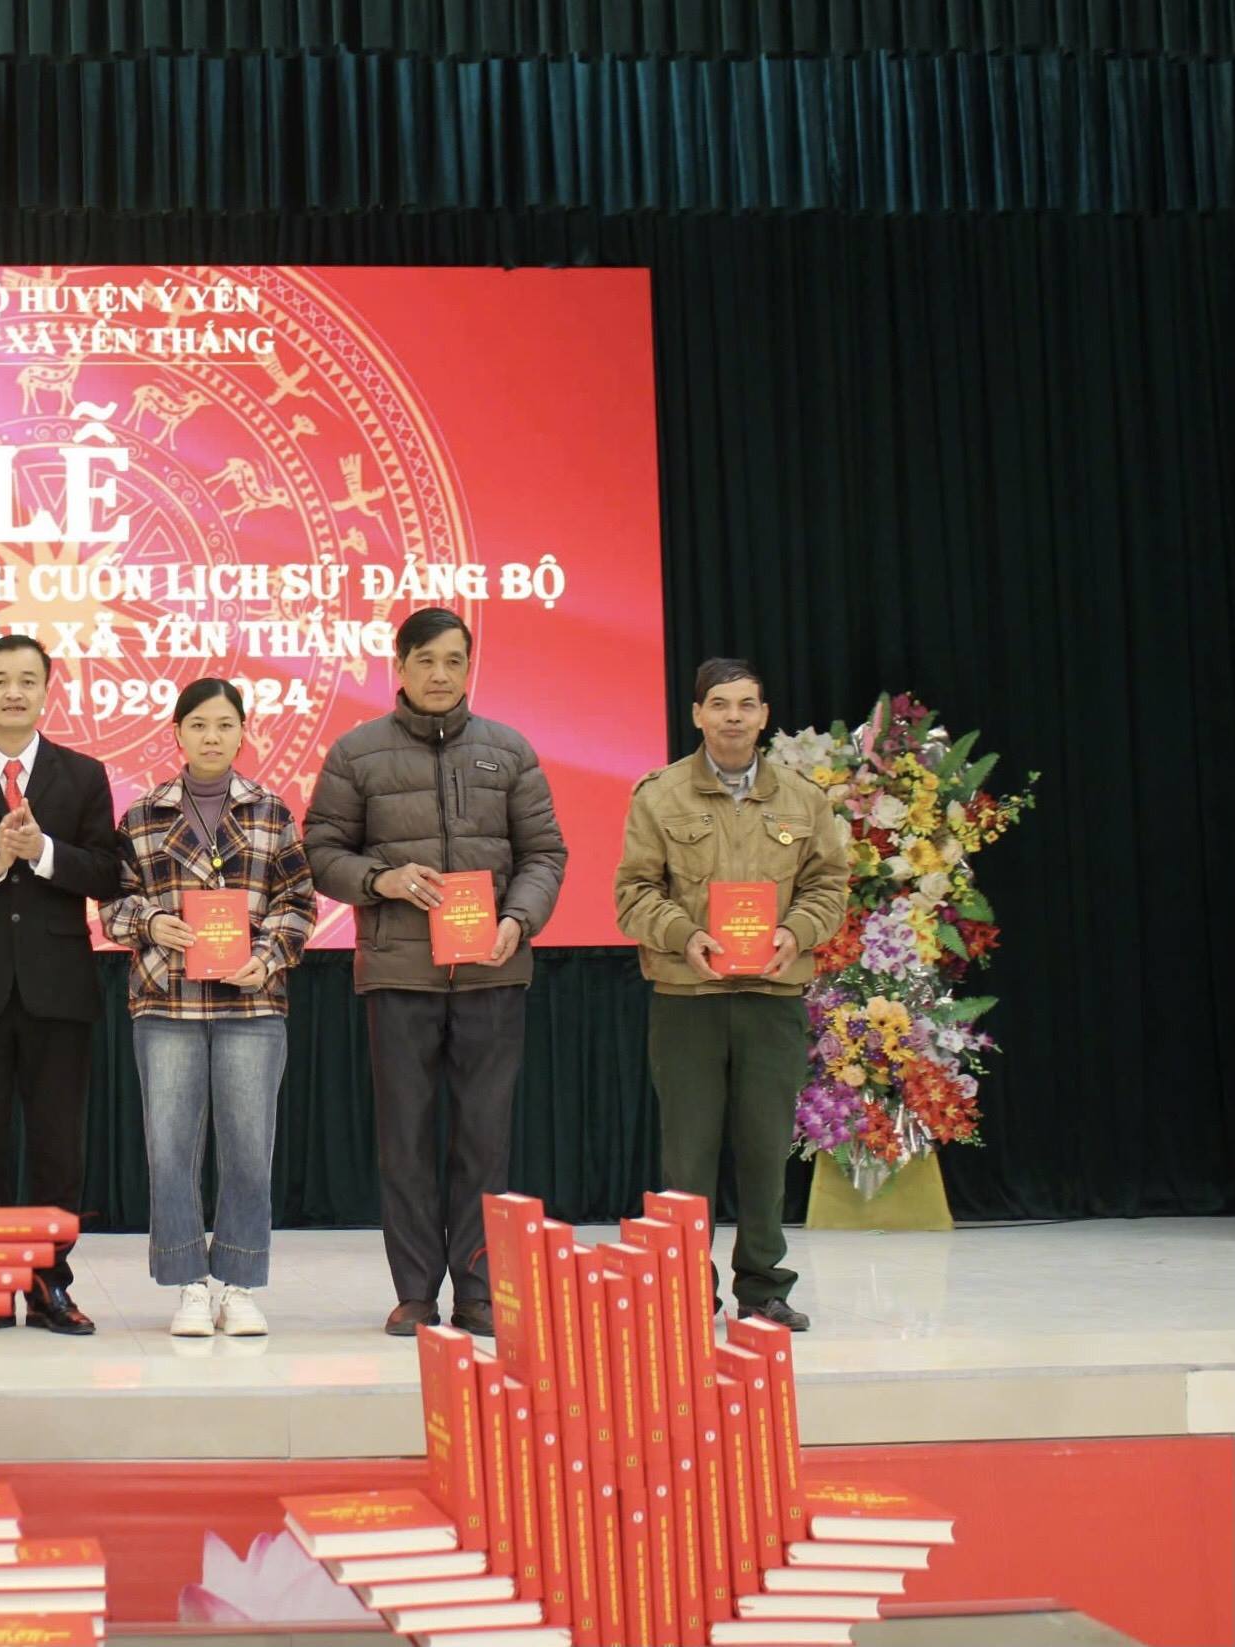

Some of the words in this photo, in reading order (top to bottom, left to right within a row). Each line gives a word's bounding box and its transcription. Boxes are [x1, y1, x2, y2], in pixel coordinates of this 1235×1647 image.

[19, 282, 143, 320] HUYỆN
[154, 278, 179, 312] Ý
[188, 278, 260, 312] YÊN
[5, 320, 56, 355] XÃ
[64, 319, 138, 354] YÊN
[146, 320, 275, 354] THẮNG
[28, 553, 152, 602] CUỐN
[167, 563, 269, 610] LỊCH
[281, 553, 348, 601] SỬ
[360, 553, 490, 600] ĐẢNG
[499, 554, 566, 609] BỘ
[50, 612, 124, 658] XÃ
[133, 611, 229, 658] YÊN
[239, 605, 396, 657] THẮNG
